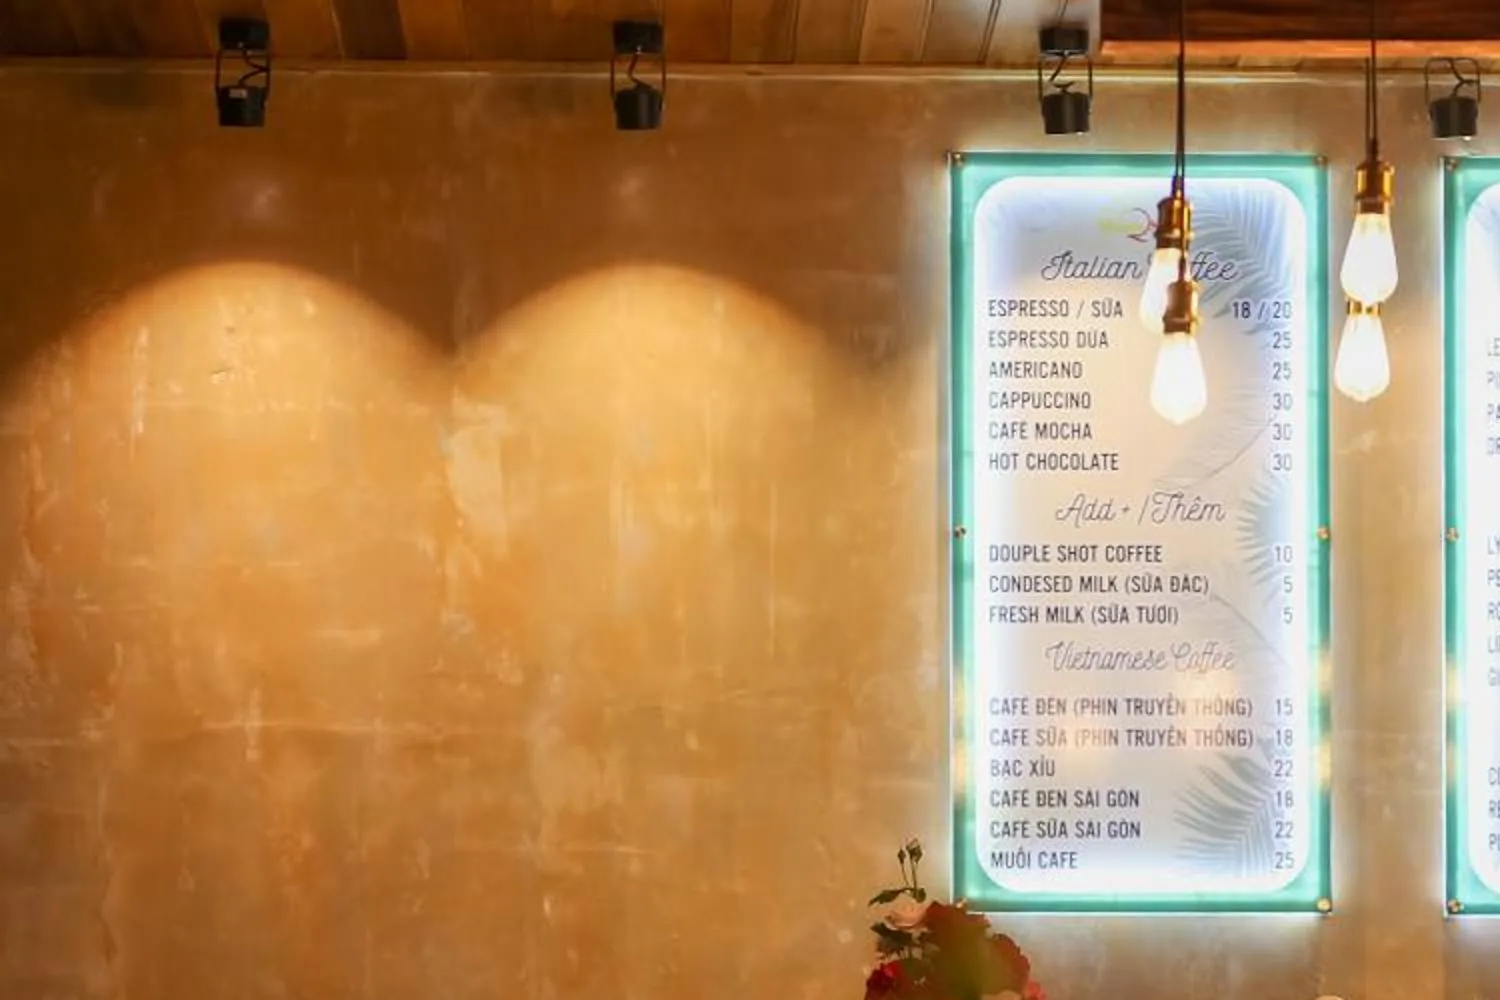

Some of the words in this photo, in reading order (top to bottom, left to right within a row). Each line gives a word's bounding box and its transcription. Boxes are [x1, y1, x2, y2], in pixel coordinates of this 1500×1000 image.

[1042, 251, 1142, 281] Italian
[989, 300, 1069, 316] ESPRESSO
[1233, 302, 1250, 319] 18
[1272, 302, 1291, 319] 20
[989, 331, 1069, 348] ESPRESSO
[1272, 332, 1291, 348] 25
[989, 362, 1082, 378] AMERICANO
[1272, 362, 1291, 379] 25
[989, 392, 1091, 408] CAPPUCCINO
[1273, 393, 1291, 410] 30
[1036, 422, 1092, 439] MOCHA
[1273, 424, 1291, 440] 30
[989, 454, 1017, 470] HOT
[1026, 454, 1119, 470] CHOCOLATE
[1273, 455, 1291, 471] 30
[1056, 493, 1114, 528] Add
[989, 546, 1050, 562] DOUPLE
[1058, 546, 1098, 562] SHOT
[1106, 546, 1162, 562] COFFEE
[1276, 546, 1292, 562] 10
[989, 576, 1072, 592] CONDESED
[1080, 576, 1118, 592] MILK
[1284, 576, 1292, 593] 5
[989, 607, 1039, 623] FRESH
[1046, 607, 1084, 623] MILK
[1284, 607, 1292, 623] 5
[1046, 641, 1166, 671] Vietnamese
[1171, 640, 1236, 674] Coffee
[1074, 699, 1117, 716] (PHIN
[1276, 699, 1292, 715] 15
[1075, 729, 1119, 748] (PHIN
[1276, 729, 1292, 746] 18
[1274, 760, 1293, 777] 22
[1276, 791, 1293, 807] 18
[1276, 822, 1293, 838] 22
[1276, 853, 1294, 869] 25
